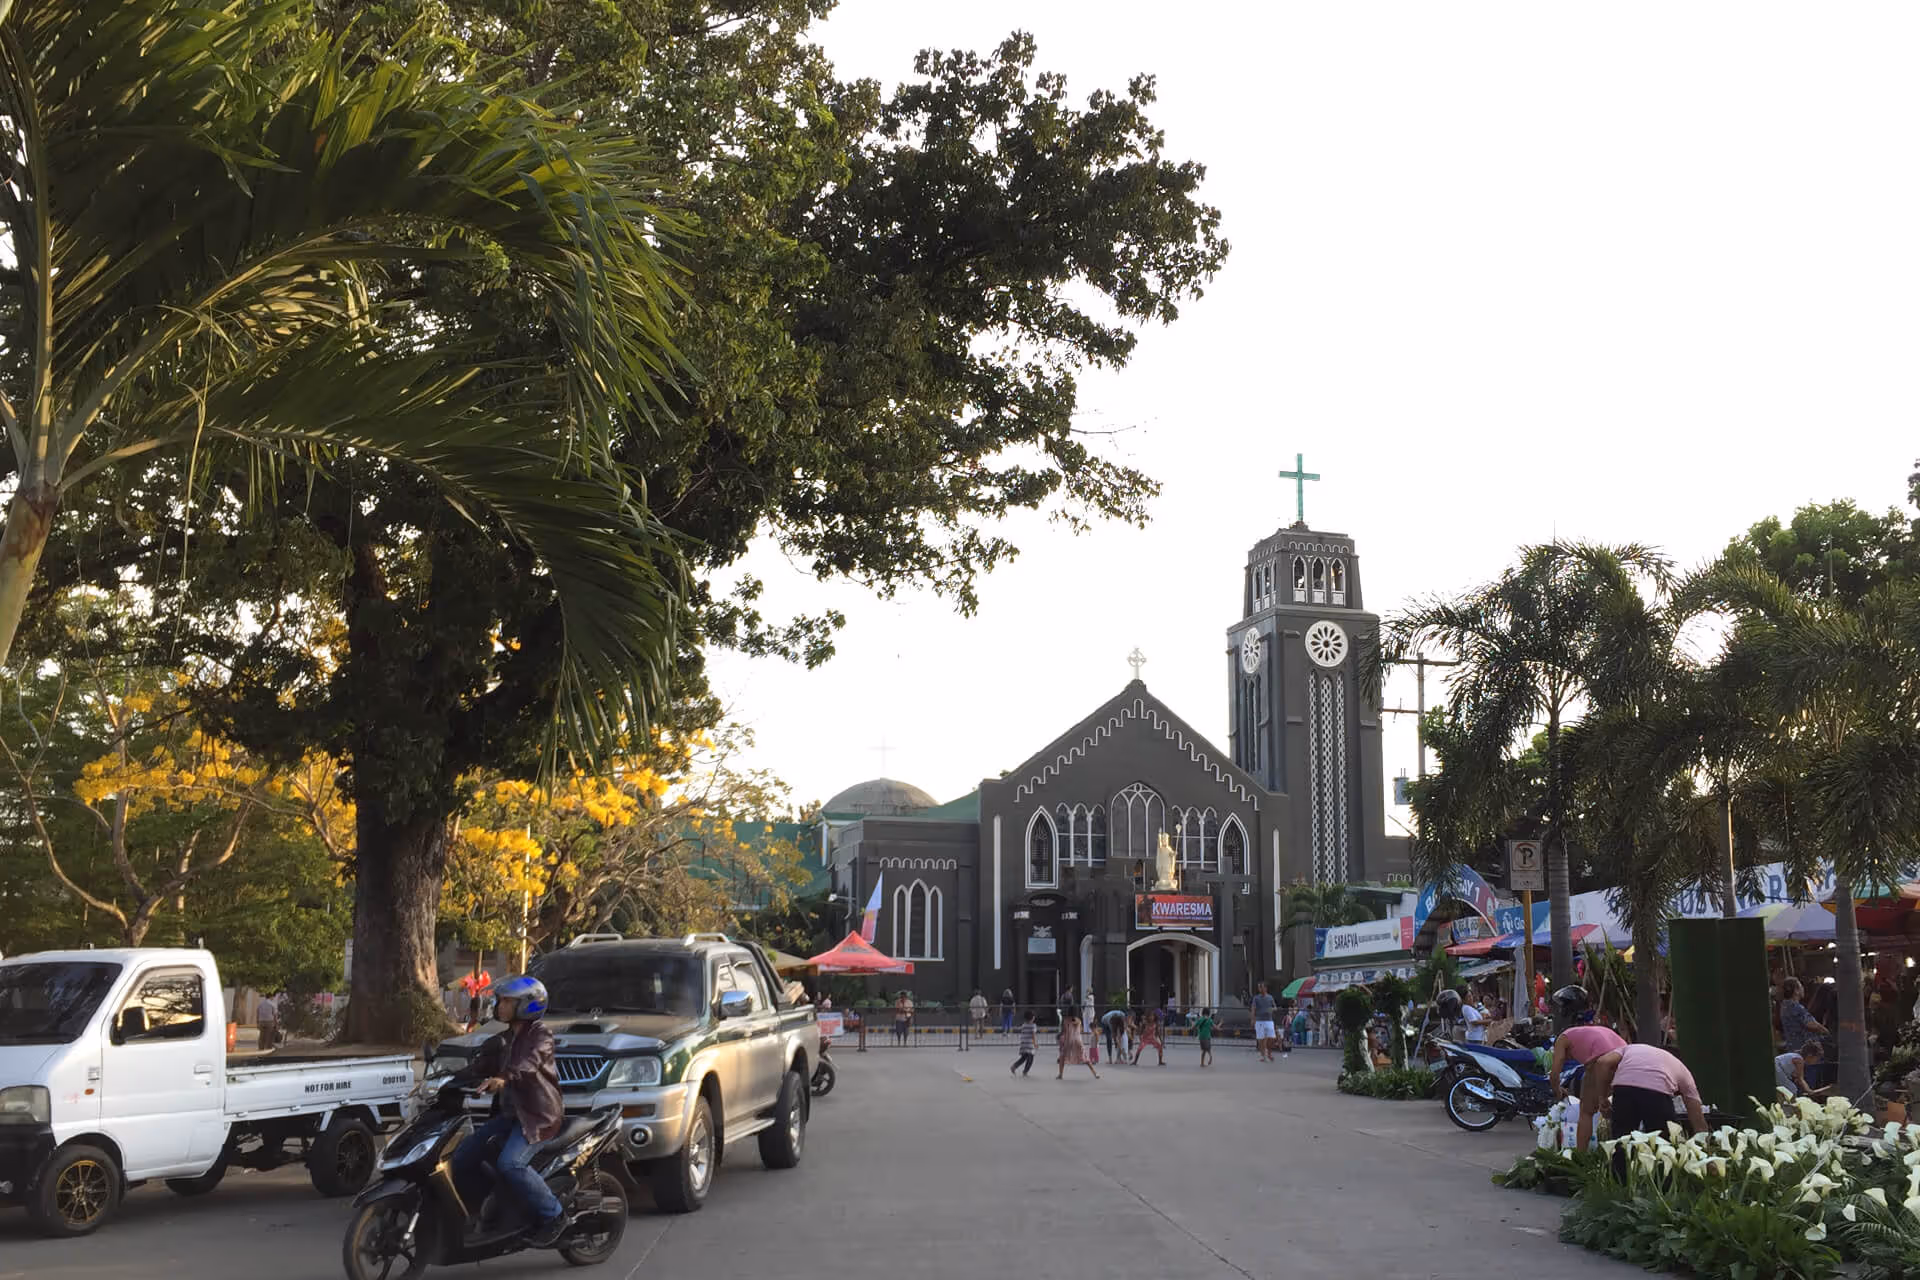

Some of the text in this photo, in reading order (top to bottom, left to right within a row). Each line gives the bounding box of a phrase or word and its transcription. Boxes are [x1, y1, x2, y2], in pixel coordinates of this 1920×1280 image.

[1152, 902, 1212, 915] KWARESMA
[305, 1080, 352, 1093] NOT FOR HIRE
